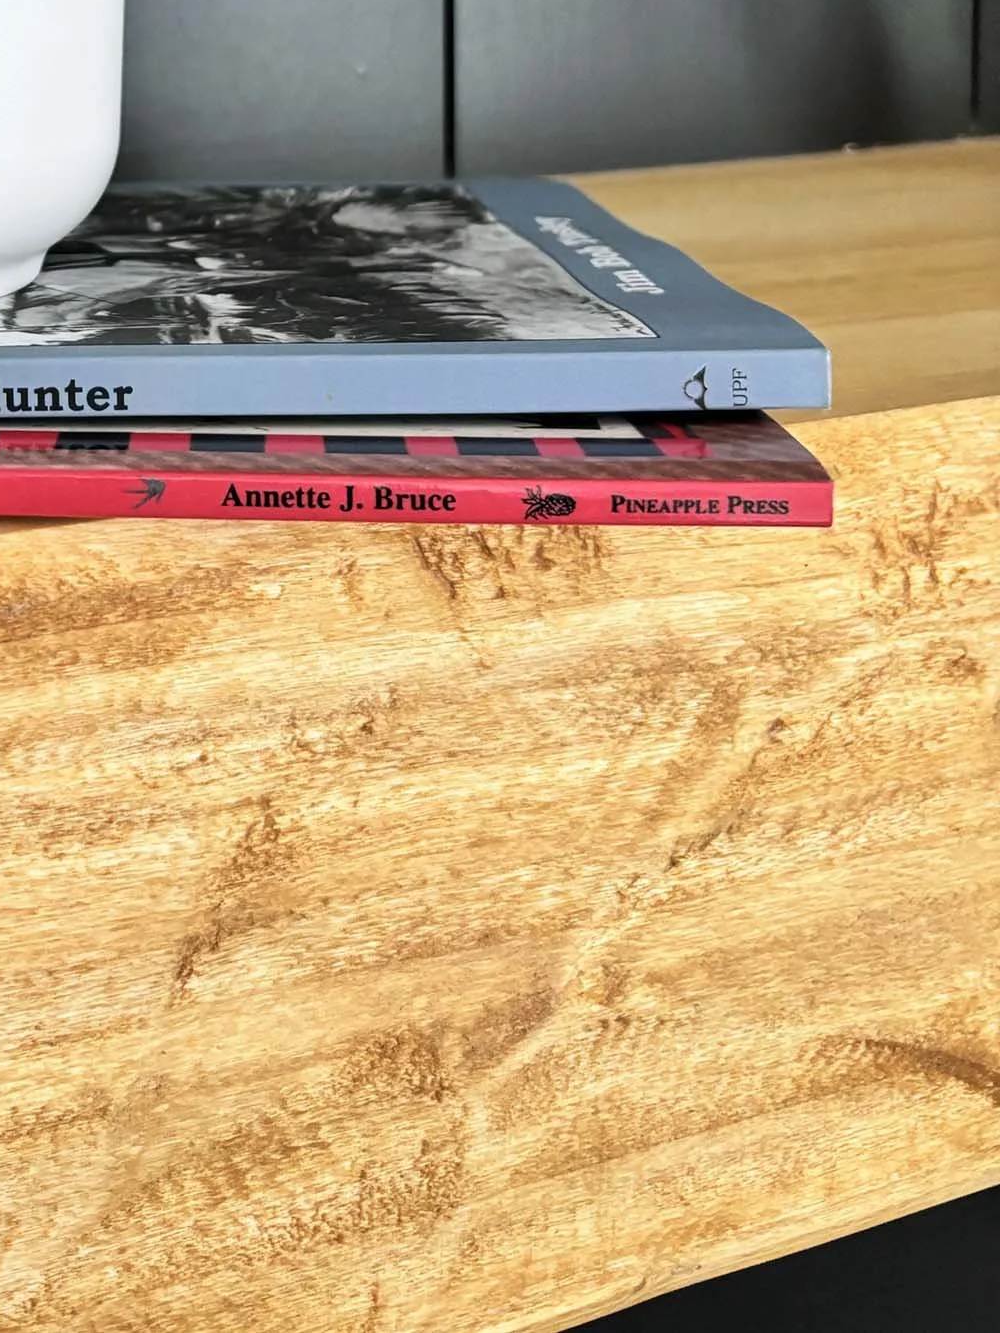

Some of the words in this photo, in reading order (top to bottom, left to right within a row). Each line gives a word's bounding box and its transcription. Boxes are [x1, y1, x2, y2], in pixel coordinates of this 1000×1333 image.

[731, 367, 748, 408] UPF
[221, 483, 331, 510] Annette
[339, 484, 364, 513] J.
[373, 485, 457, 512] Bruce
[611, 494, 720, 514] PINEAPPLE
[727, 495, 790, 515] PRESS
